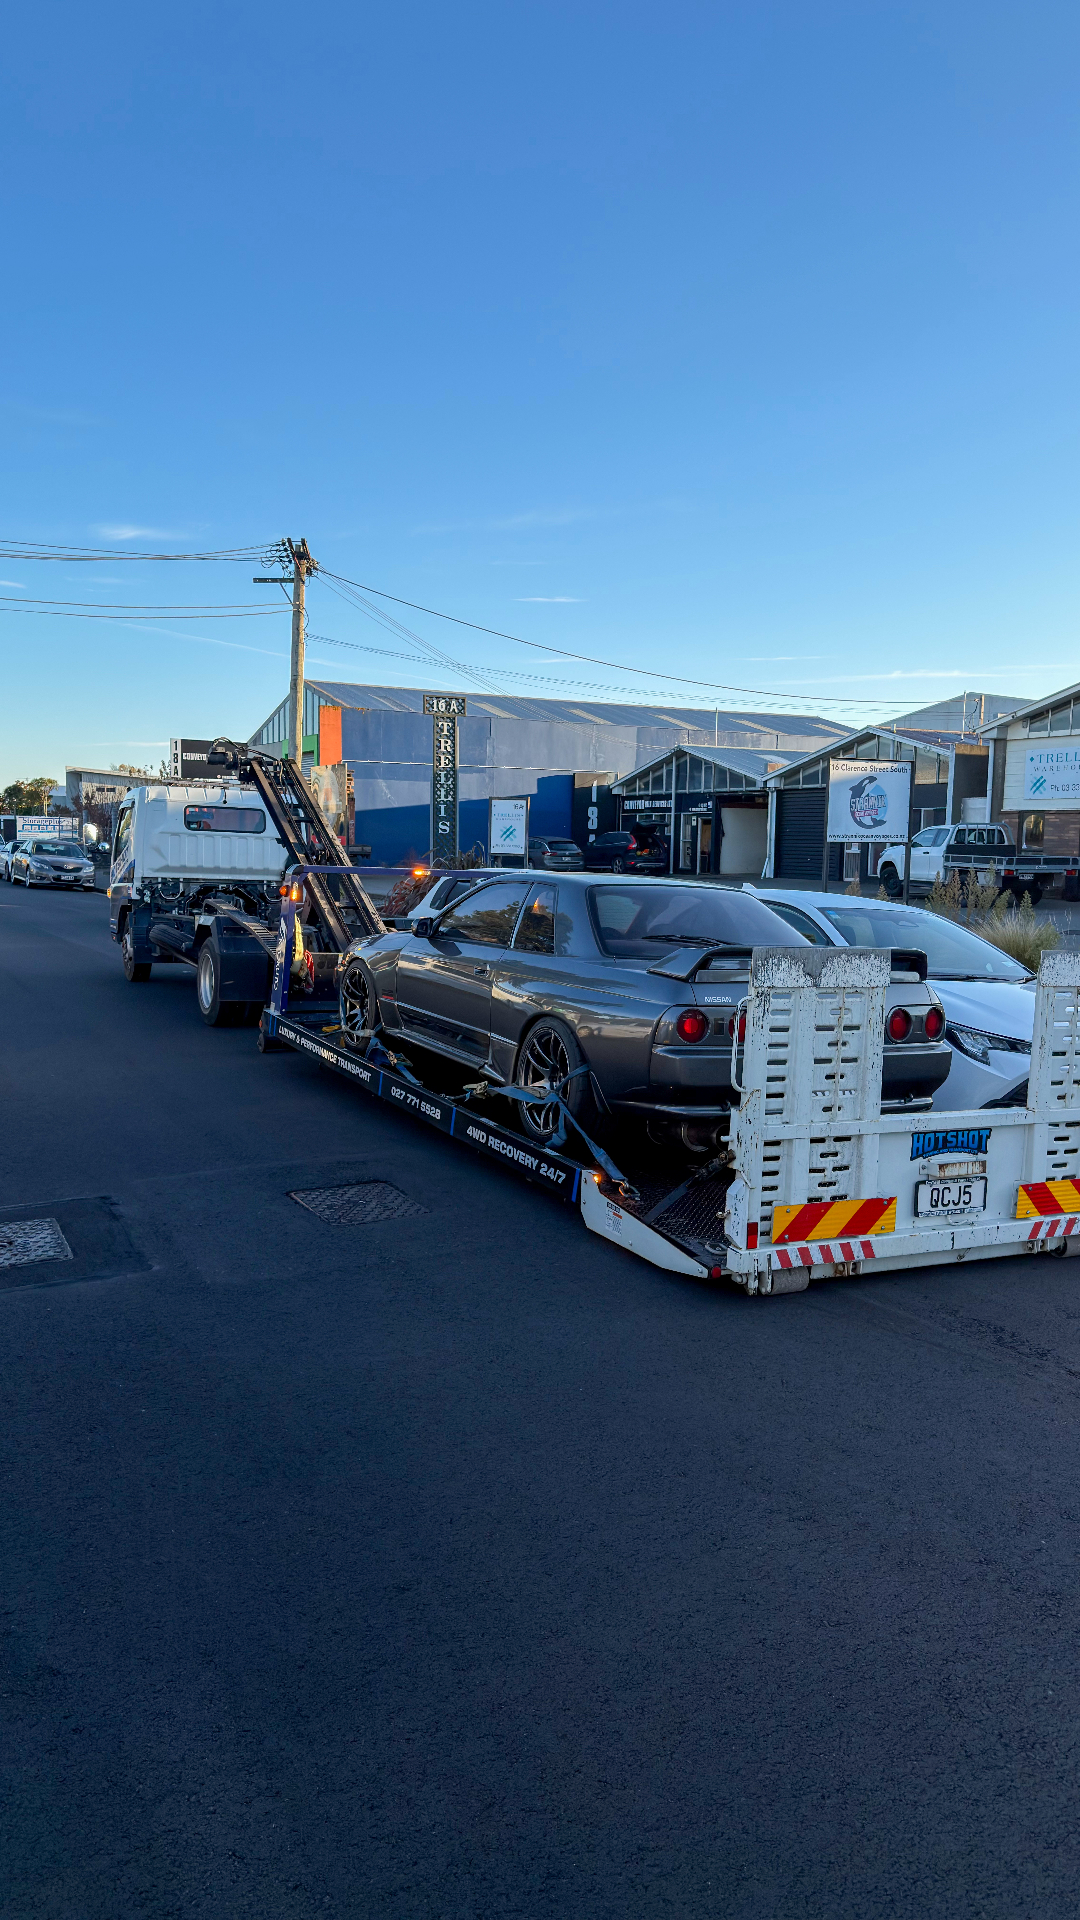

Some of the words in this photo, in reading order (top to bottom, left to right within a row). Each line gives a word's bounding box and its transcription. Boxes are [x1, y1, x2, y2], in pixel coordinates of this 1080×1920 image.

[432, 700, 445, 711] 16
[450, 700, 458, 712] A
[182, 752, 207, 761] CONVEYO
[831, 763, 840, 771] 16
[841, 763, 868, 772] Clarence
[869, 764, 889, 773] Street
[889, 765, 908, 774] South
[438, 721, 453, 834] TRELLIS
[278, 1025, 297, 1041] LUXURY
[295, 1034, 301, 1044] &
[300, 1037, 338, 1064] PERFORMANCE
[338, 1056, 372, 1083] TRANSPORT
[391, 1086, 405, 1099] 027
[406, 1093, 420, 1109] 771
[420, 1101, 441, 1120] 5528
[466, 1125, 487, 1143] 4WD
[488, 1135, 539, 1171] RECOVERY
[540, 1162, 567, 1184] 24/7
[911, 1128, 991, 1159] HOTSHOT
[929, 1184, 973, 1209] QCJ5
